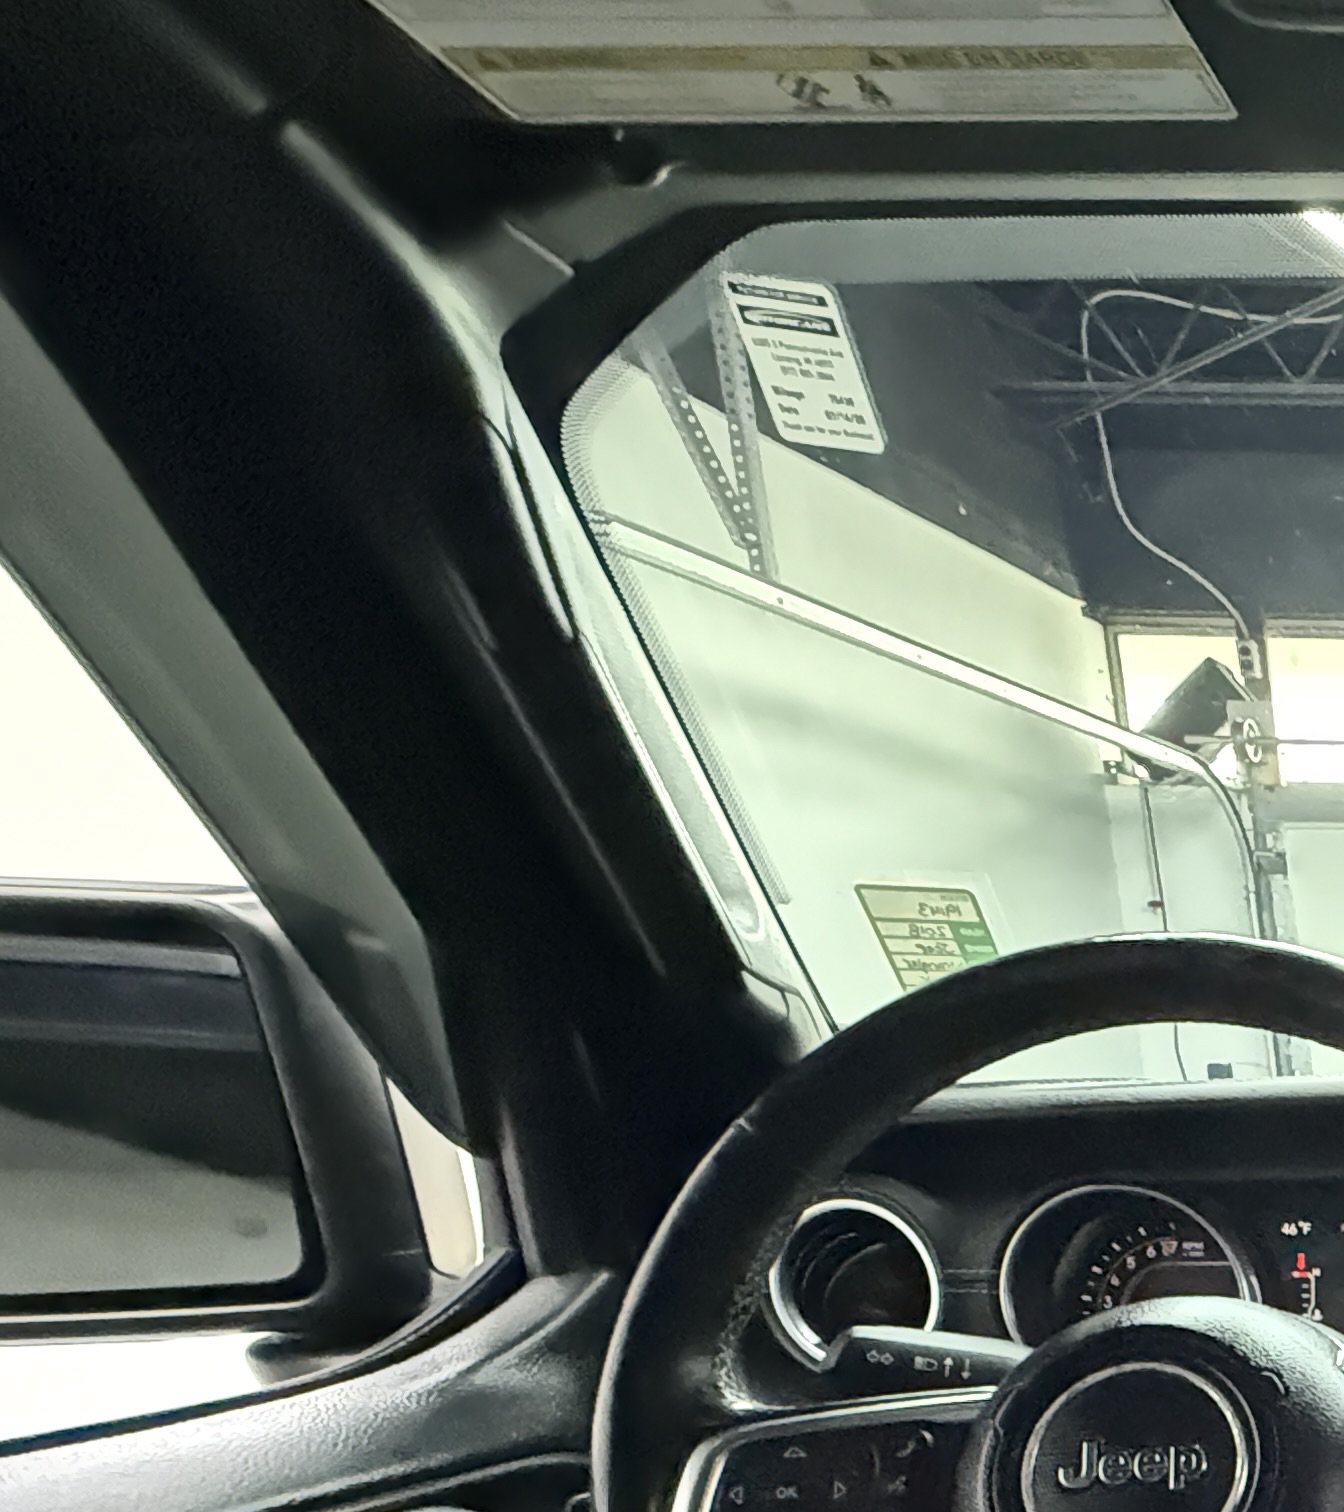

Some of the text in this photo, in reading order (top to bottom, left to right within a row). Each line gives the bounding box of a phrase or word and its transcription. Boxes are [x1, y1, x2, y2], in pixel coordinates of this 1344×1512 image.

[1126, 1256, 1136, 1270] 5
[1057, 1440, 1208, 1490] Jeep
[775, 1486, 798, 1499] OK
